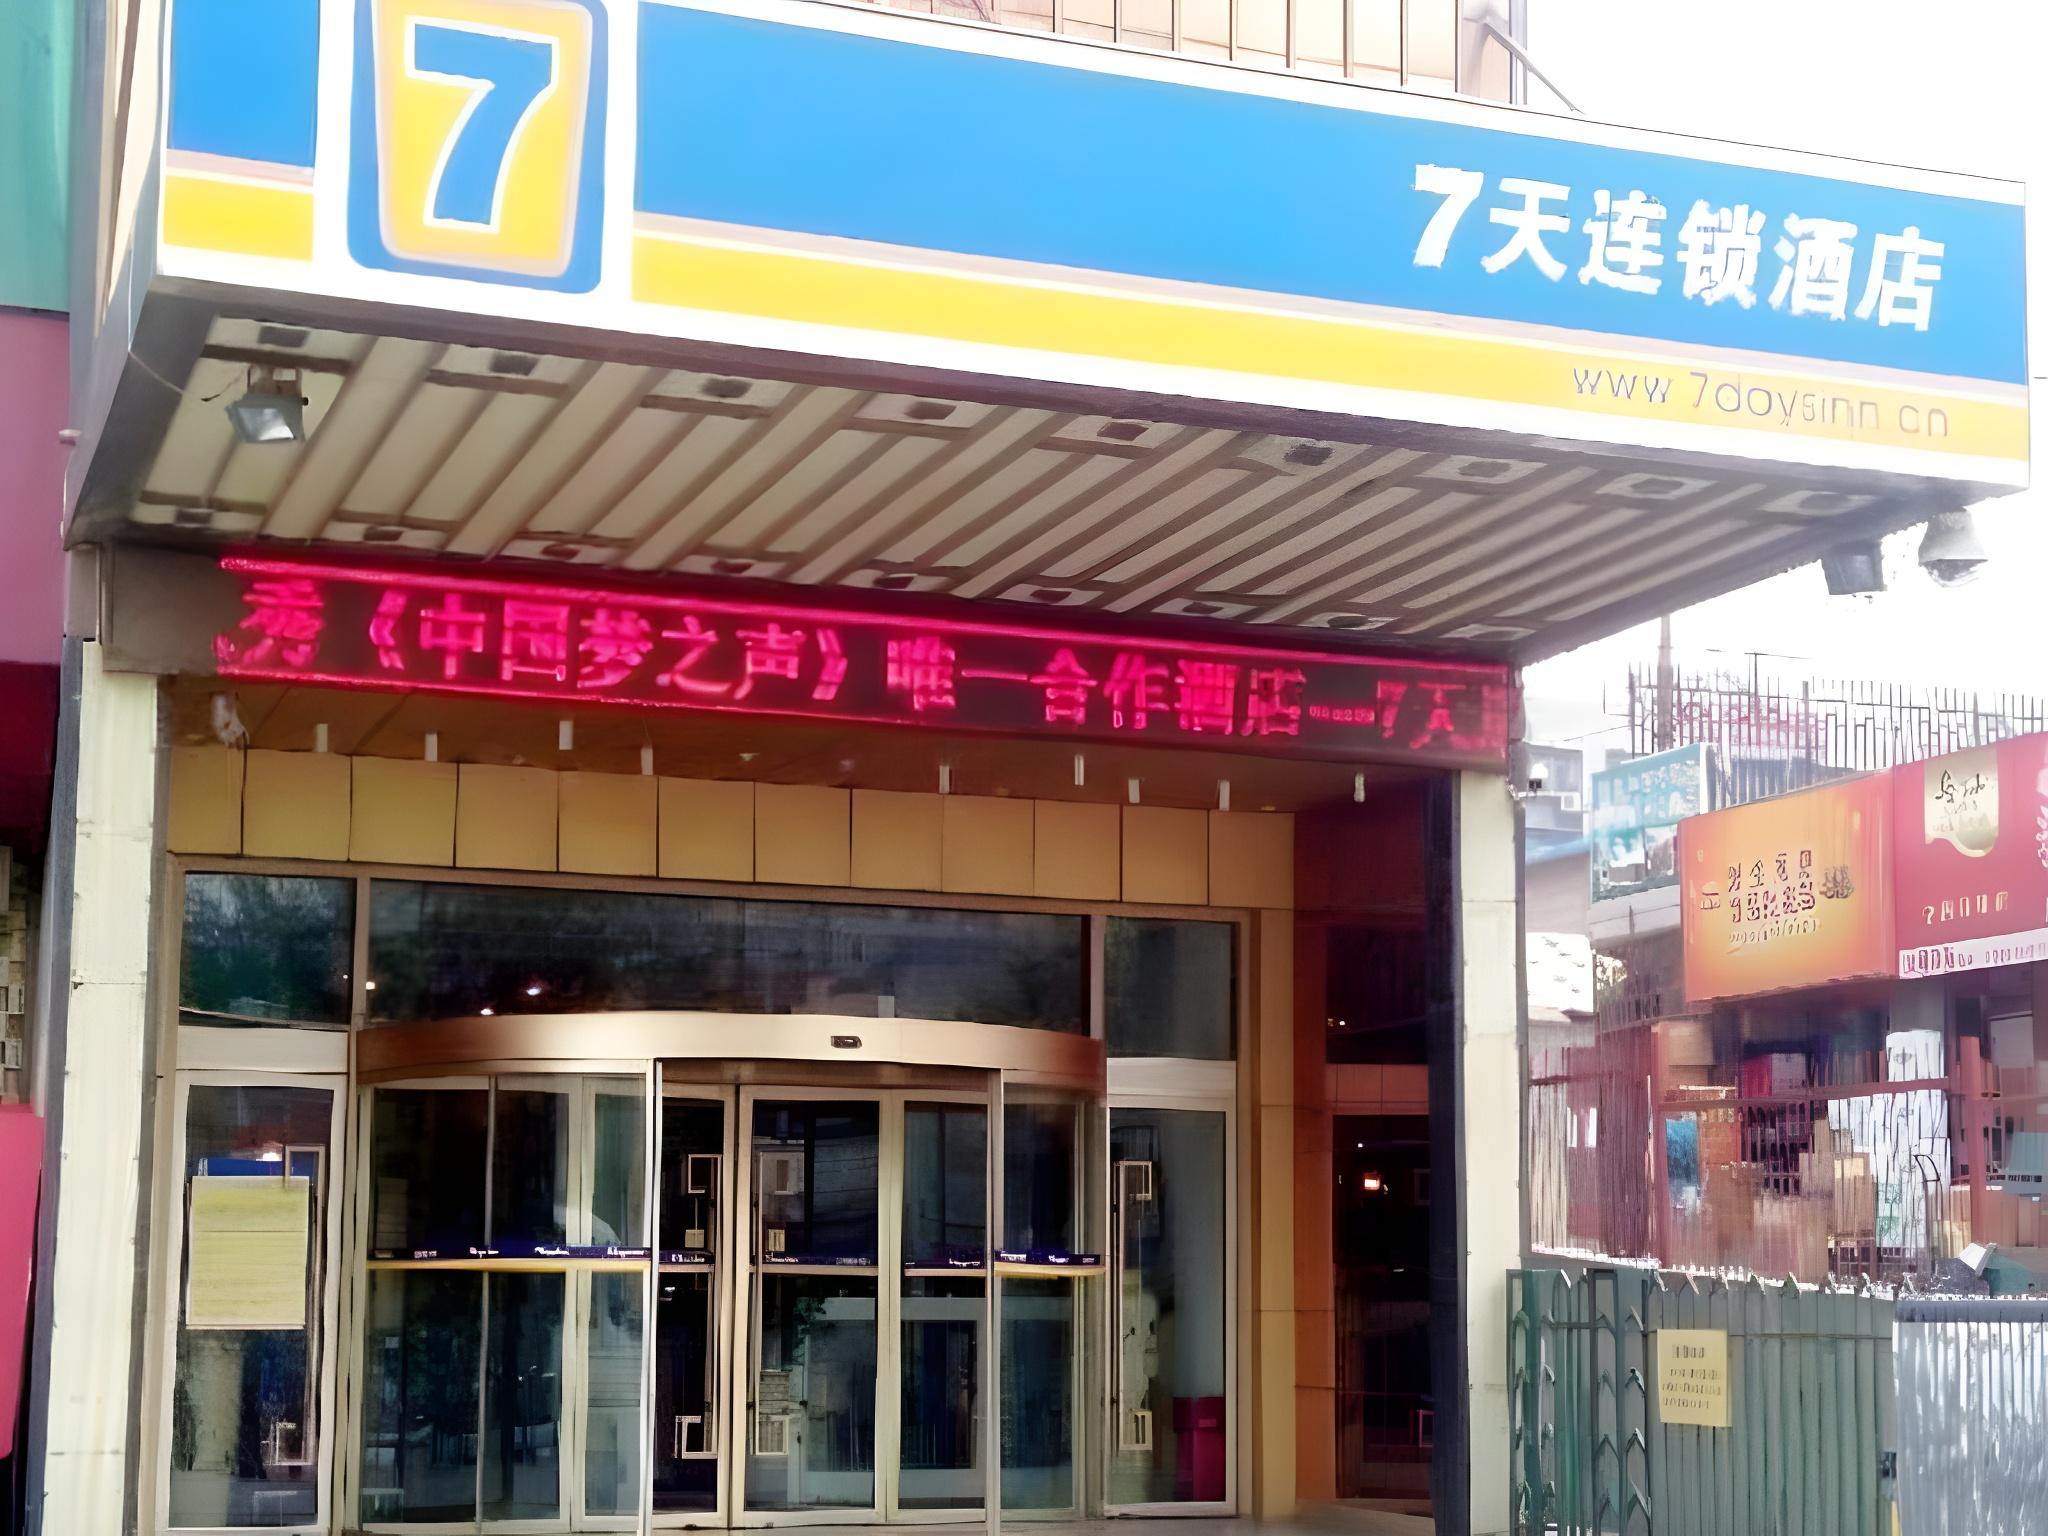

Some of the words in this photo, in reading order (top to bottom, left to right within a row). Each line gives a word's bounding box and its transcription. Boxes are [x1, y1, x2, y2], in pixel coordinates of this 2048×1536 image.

[404, 14, 560, 235] 7
[1412, 162, 1945, 332] 7天连锁酒店
